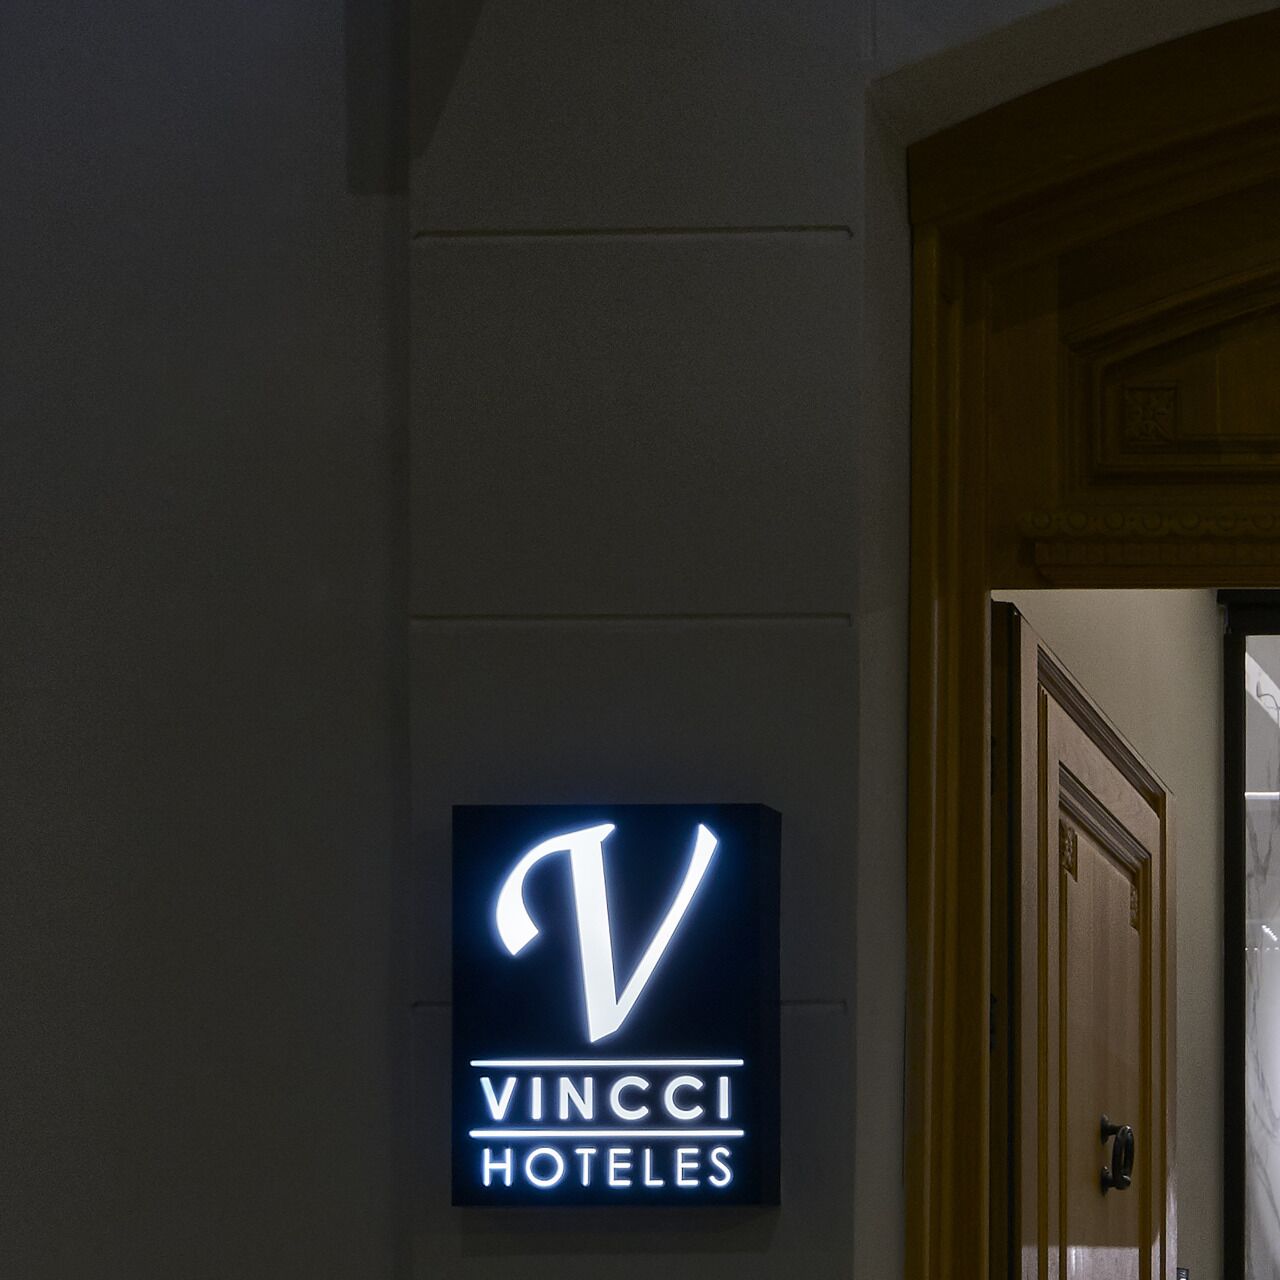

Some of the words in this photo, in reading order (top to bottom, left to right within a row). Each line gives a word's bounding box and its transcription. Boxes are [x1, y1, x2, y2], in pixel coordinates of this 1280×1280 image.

[495, 823, 718, 1043] V
[479, 1075, 730, 1121] VINCCI
[482, 1146, 733, 1188] HOTELES
